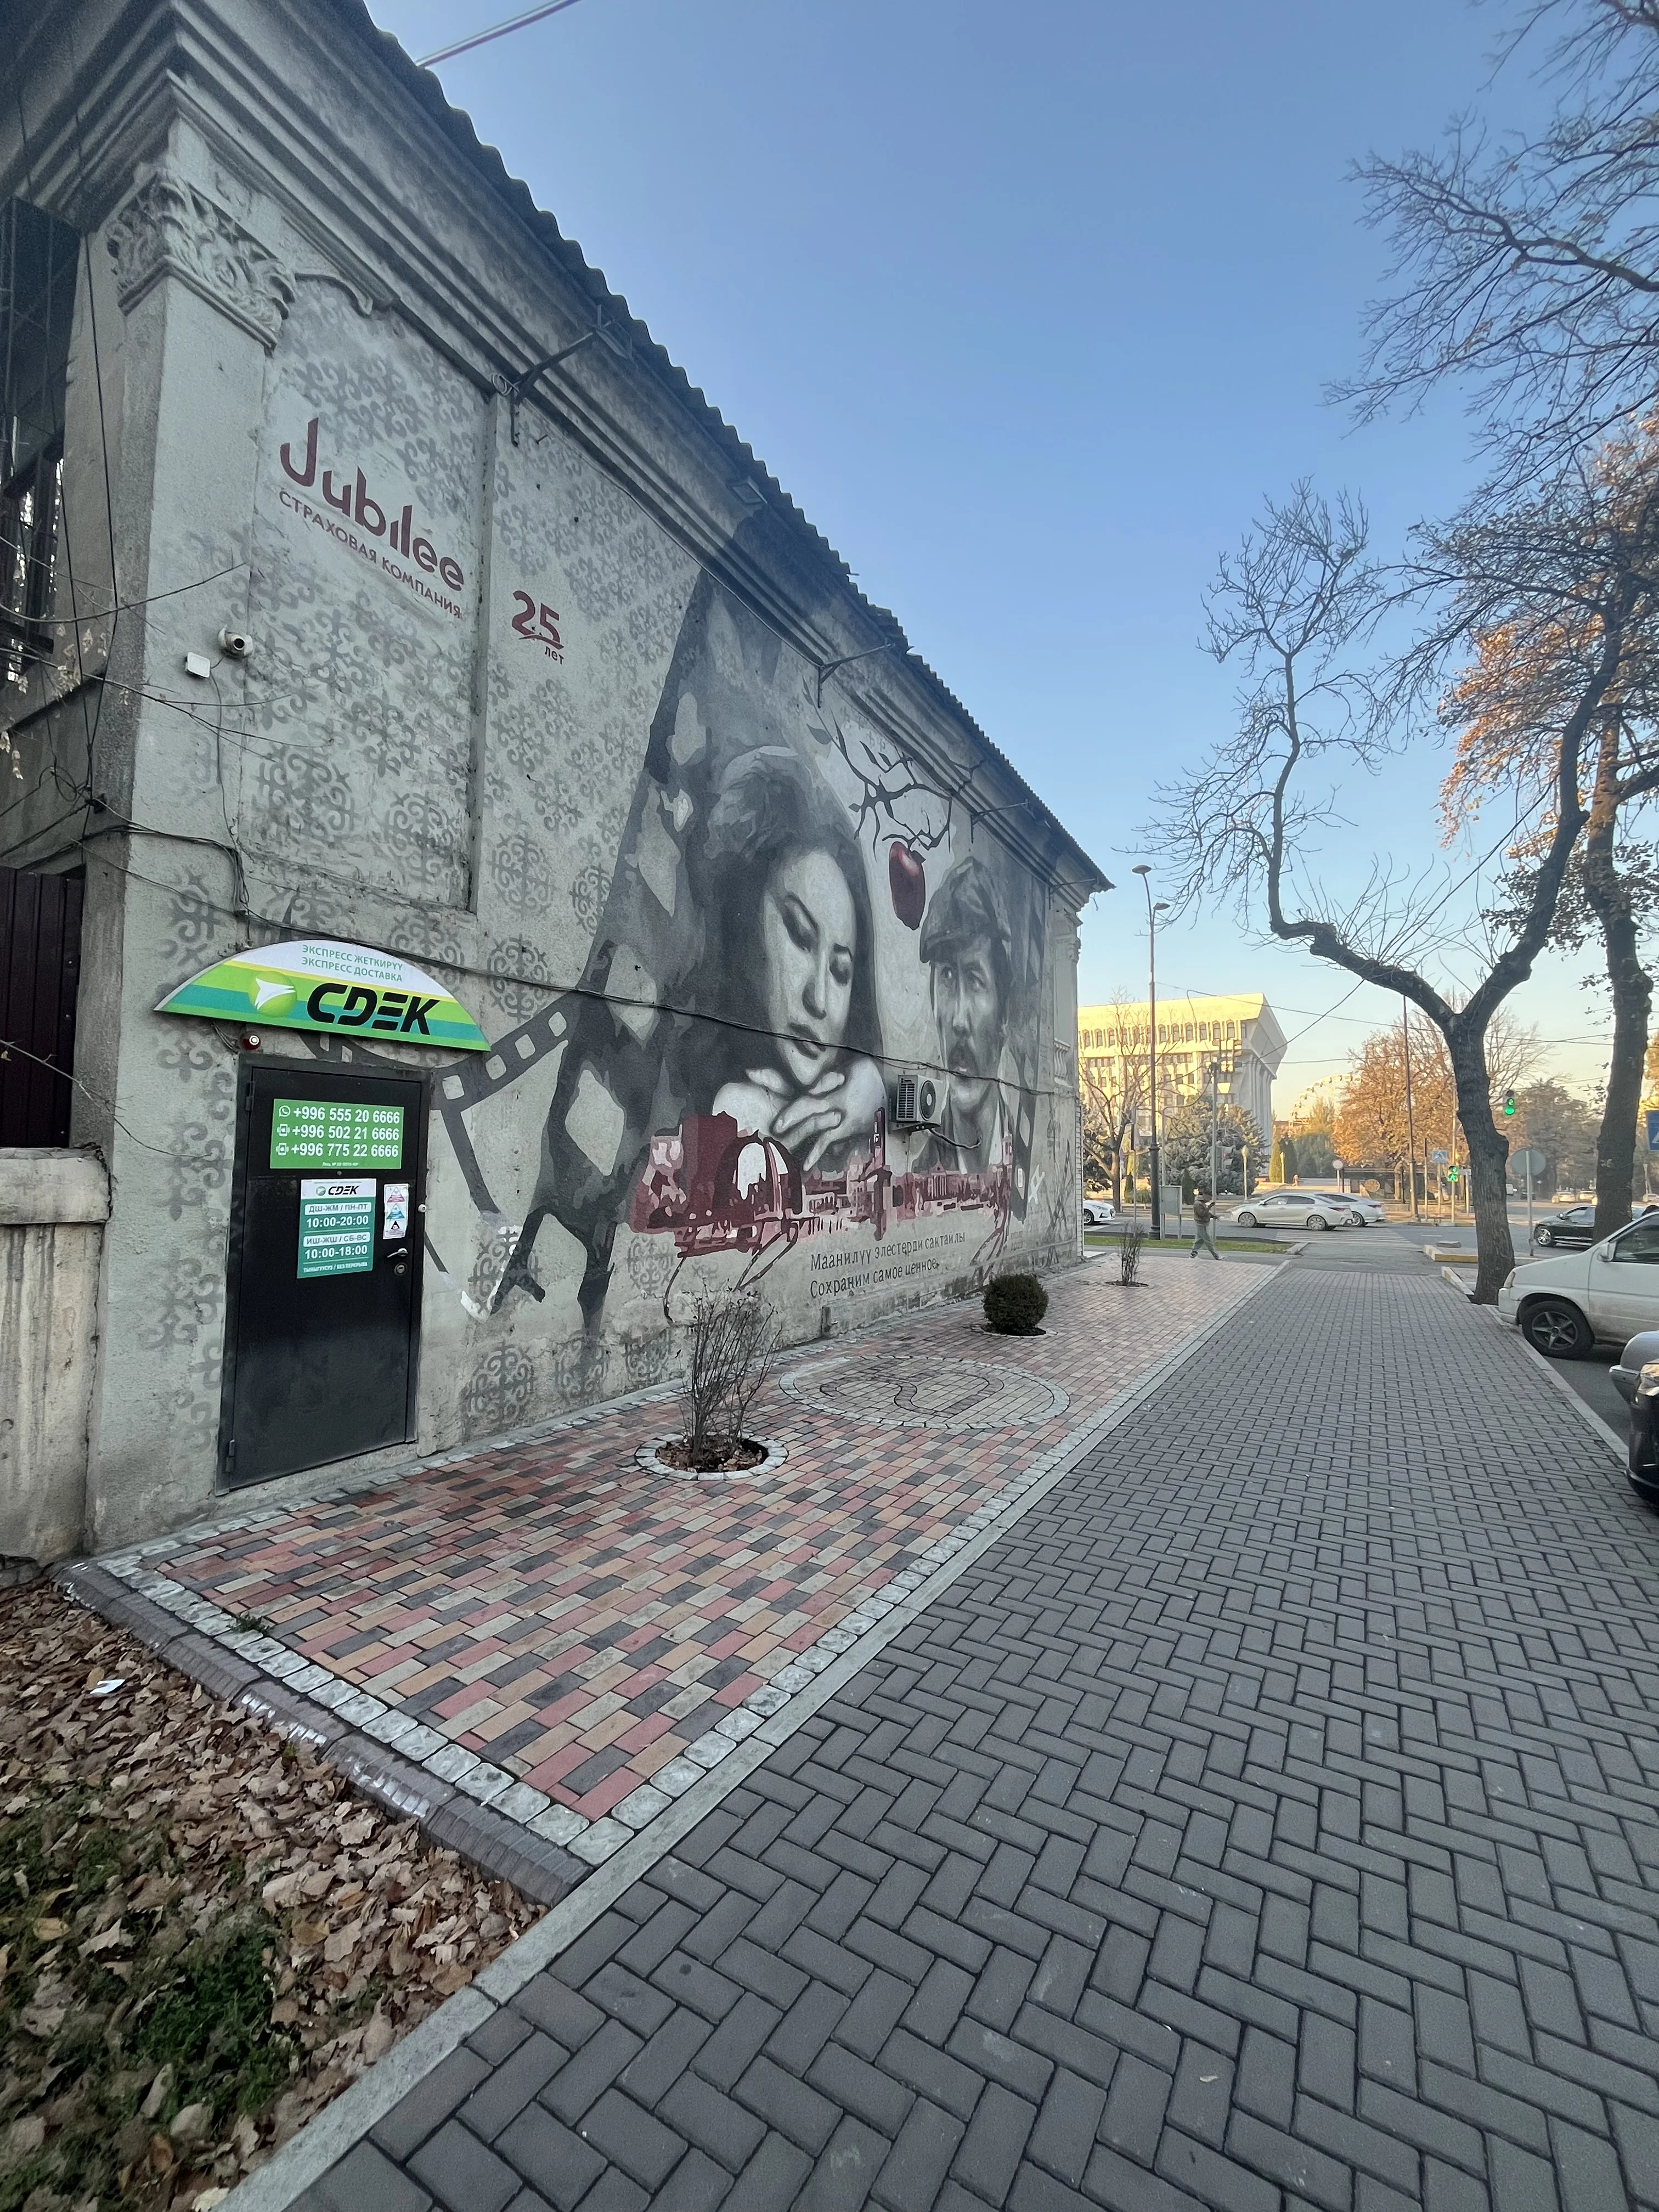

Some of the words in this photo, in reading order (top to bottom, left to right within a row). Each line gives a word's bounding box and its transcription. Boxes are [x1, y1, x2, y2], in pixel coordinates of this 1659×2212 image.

[280, 417, 464, 591] Jubilee
[279, 490, 377, 563] СТРАХОВАЯ
[382, 557, 461, 619] КОМПАНИЯ
[512, 590, 561, 644] 25
[544, 646, 564, 665] лет
[302, 944, 353, 962] ЭКСПРЕСС
[301, 956, 352, 973] ЭКСПРЕСС
[354, 967, 403, 982] ДОСТАВКА
[307, 983, 441, 1036] CDEK
[293, 1106, 325, 1120] +996
[329, 1108, 352, 1122] 555
[354, 1109, 369, 1122] 20
[373, 1110, 400, 1124] 6666
[292, 1124, 325, 1138] +996
[328, 1125, 351, 1139] 502
[354, 1126, 368, 1139] 21
[372, 1127, 399, 1141] 6666
[291, 1142, 323, 1156] +996
[328, 1143, 350, 1156] 775
[353, 1144, 368, 1157] 22
[371, 1144, 398, 1158] 6666
[328, 1186, 359, 1195] CDEK
[309, 1205, 338, 1213] ДШ-ЖМ
[306, 1215, 369, 1228] 10:00-20:00
[307, 1237, 337, 1245] ИШ-ЖШ
[305, 1245, 368, 1260] 10:00-18:00
[810, 1249, 871, 1271] Маанилүү
[874, 1239, 923, 1259] элестерди
[810, 1272, 870, 1299] Сохраним
[873, 1266, 903, 1284] самое
